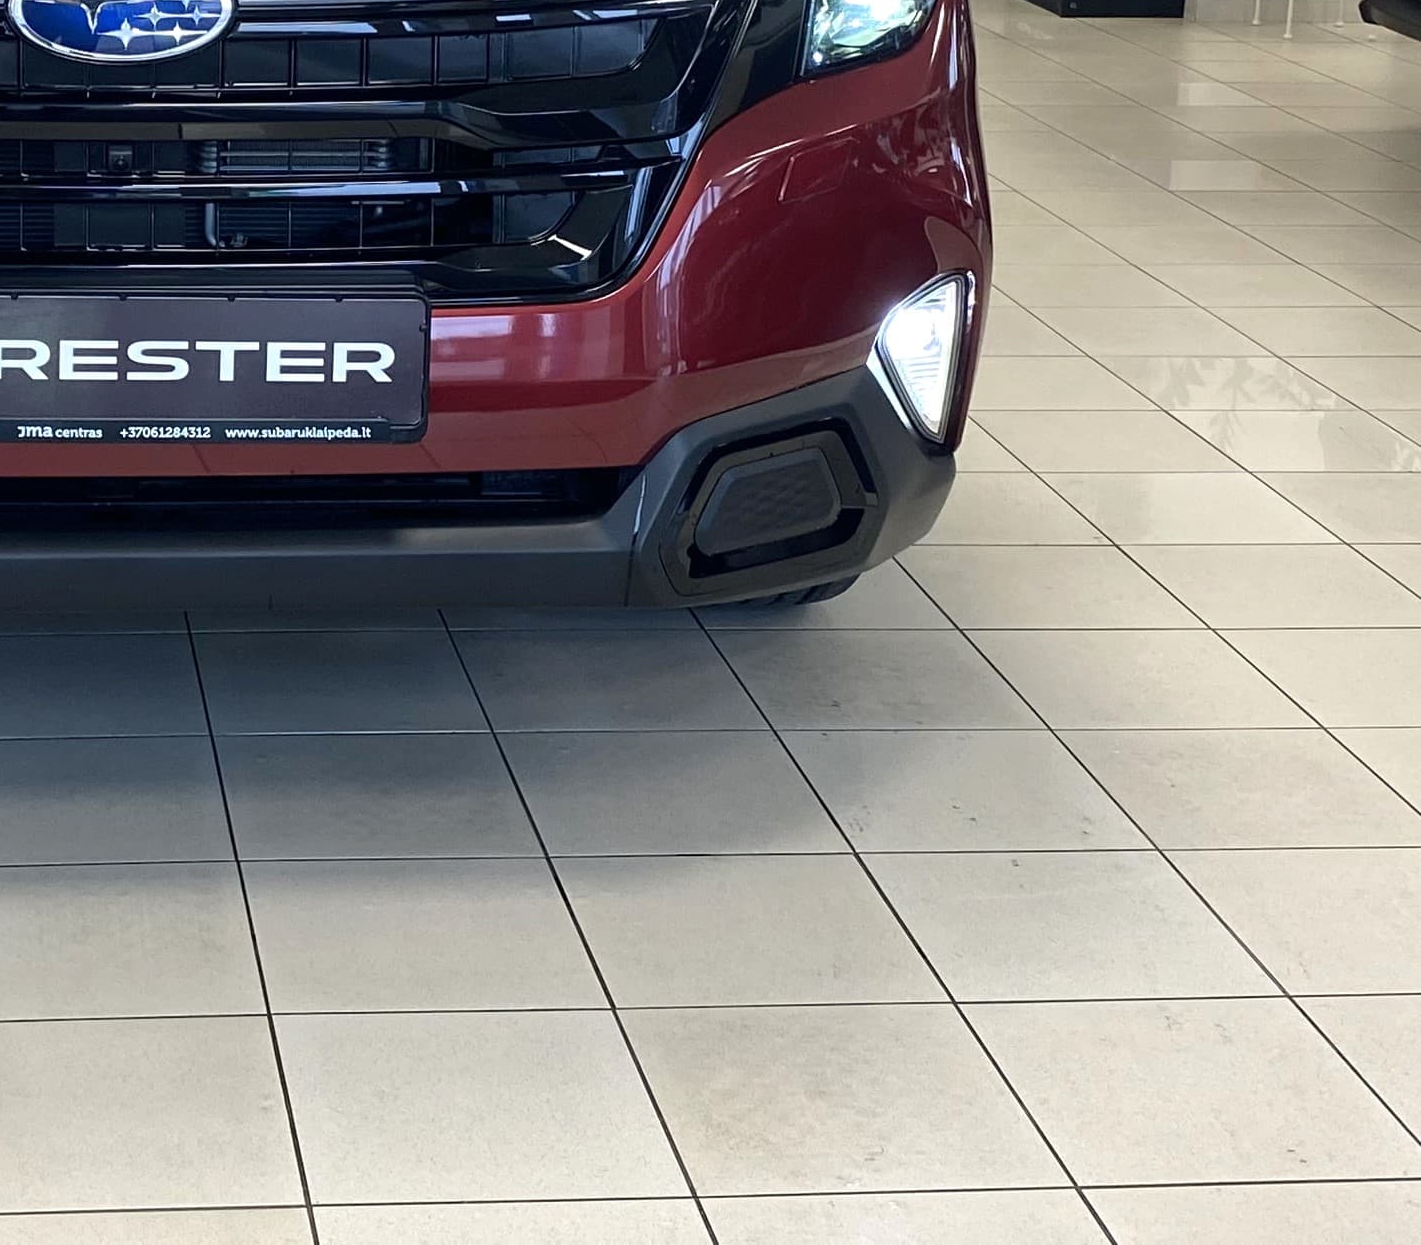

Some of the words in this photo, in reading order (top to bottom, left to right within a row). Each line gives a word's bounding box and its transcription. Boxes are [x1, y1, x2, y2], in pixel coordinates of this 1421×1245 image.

[54, 427, 103, 439] centras
[119, 426, 212, 439] +37061284312
[224, 426, 372, 441] www.subaruklaipeda.lt
